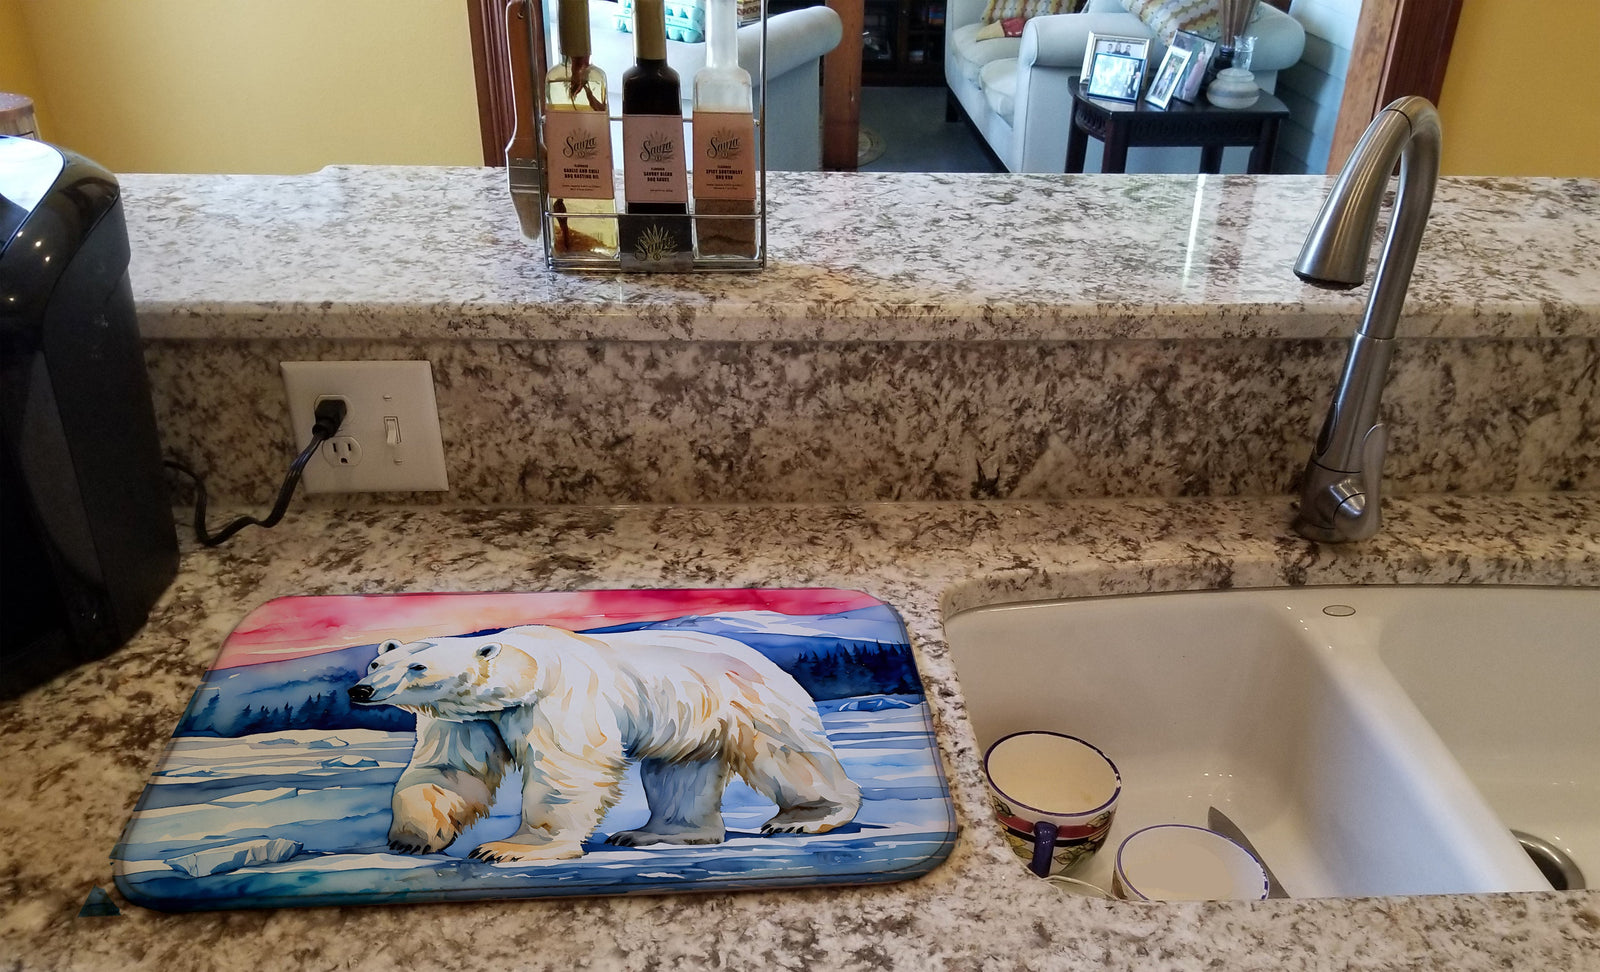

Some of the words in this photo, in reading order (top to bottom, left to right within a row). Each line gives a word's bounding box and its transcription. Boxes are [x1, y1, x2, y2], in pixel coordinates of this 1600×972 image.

[563, 136, 598, 158] Sauza
[640, 140, 674, 161] Sauza
[707, 137, 739, 158] Sauza
